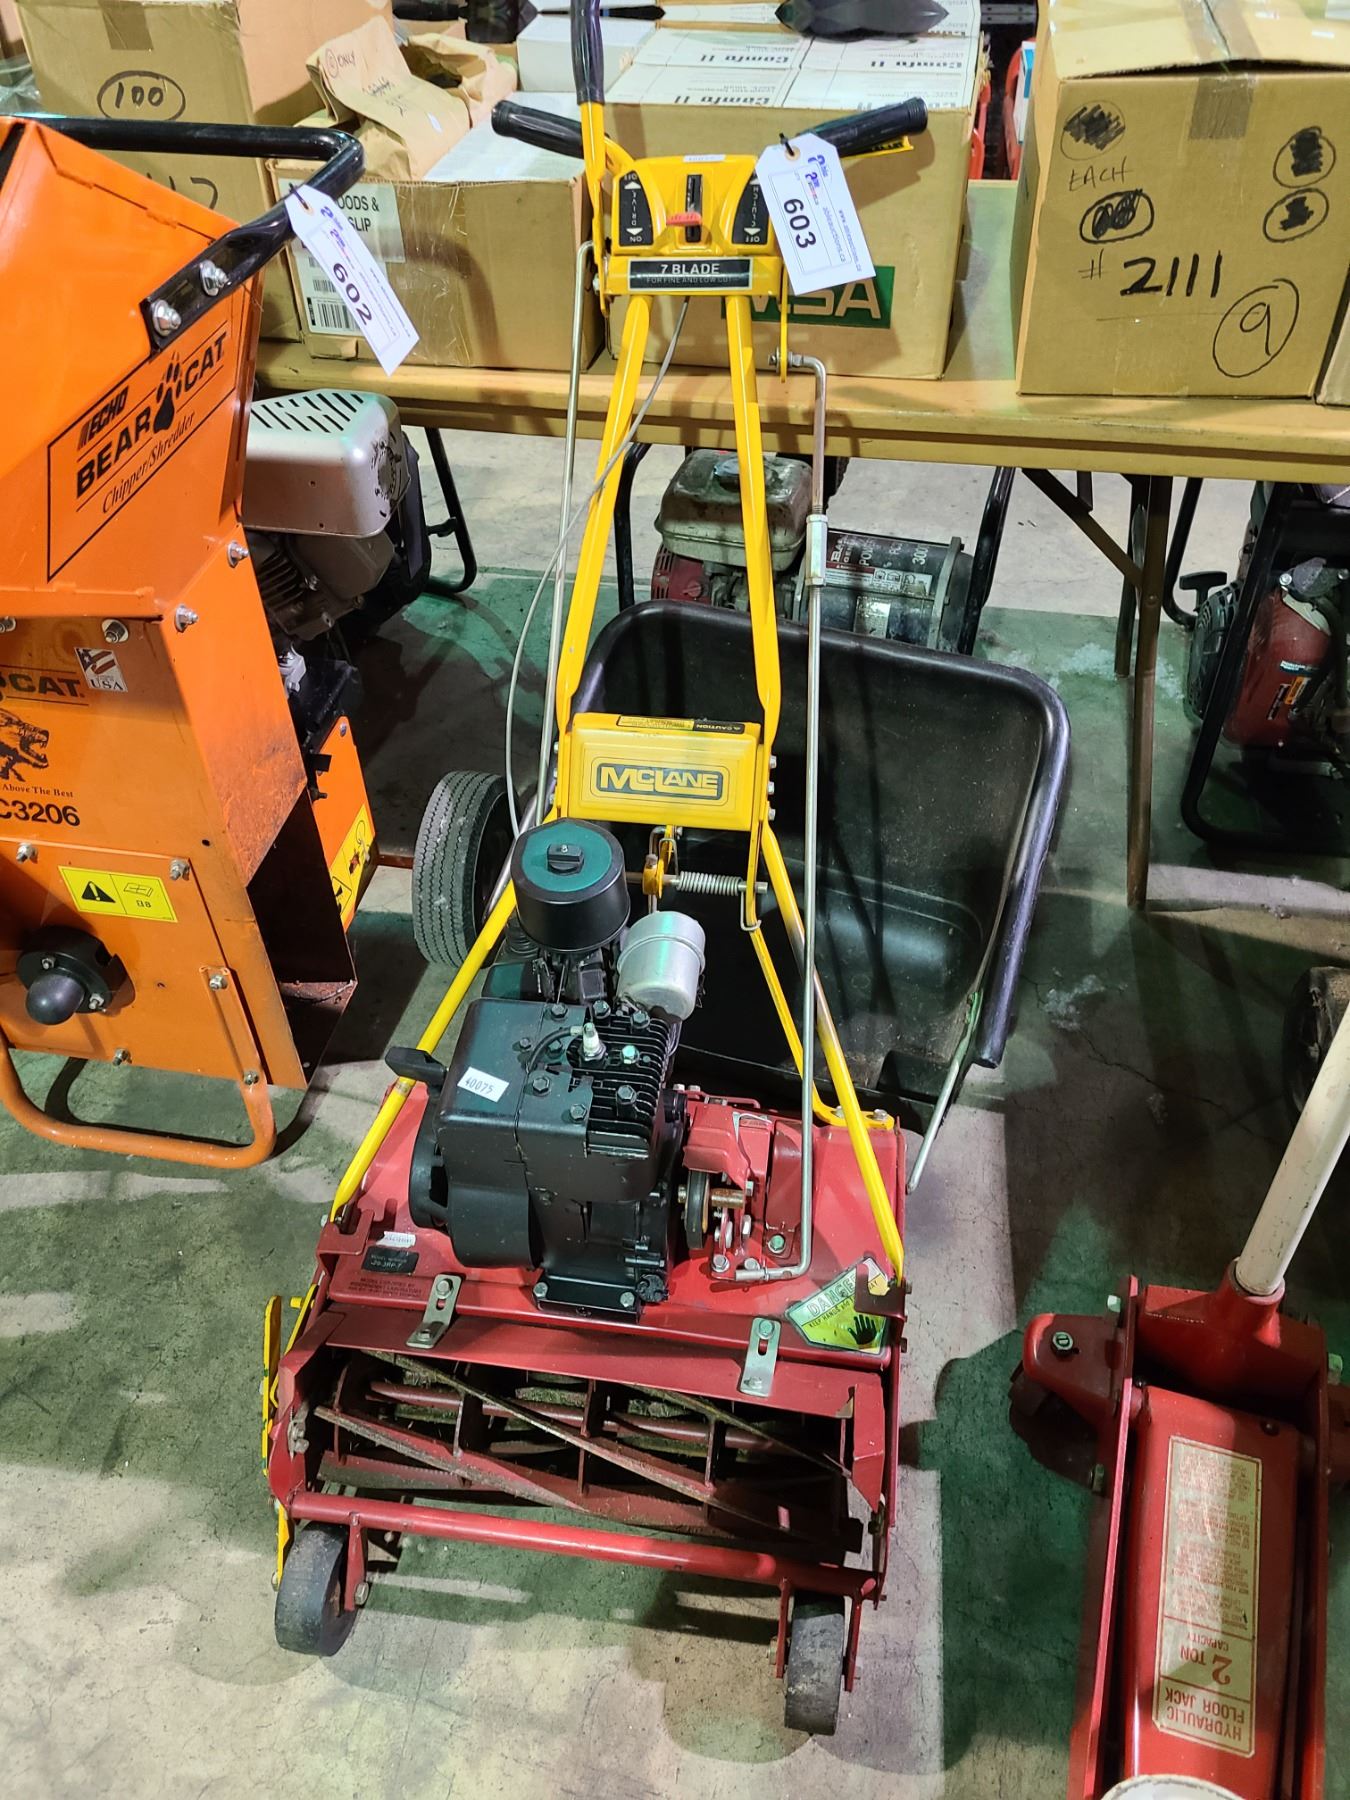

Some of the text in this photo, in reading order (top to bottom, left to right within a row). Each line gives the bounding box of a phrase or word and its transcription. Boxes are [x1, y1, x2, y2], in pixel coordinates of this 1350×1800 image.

[115, 79, 164, 109] 100
[1069, 156, 1133, 192] EACH
[337, 194, 381, 213] OODS &
[629, 235, 642, 243] ON
[745, 235, 761, 243] OFF
[783, 198, 817, 249] 603
[660, 263, 720, 275] 7 BLADE
[1120, 250, 1223, 298] 2111
[333, 263, 373, 326] 602
[76, 332, 227, 499] BEAR CAT
[84, 386, 129, 446] ECHO
[102, 410, 195, 514] Chipper/Shredder
[90, 679, 124, 691] USA
[3, 783, 74, 798] Above The Best
[464, 1076, 496, 1096] 40075
[807, 1274, 856, 1318] DANGE
[1187, 1632, 1230, 1652] CAPACITY
[1180, 1645, 1233, 1686] 2 TON
[1165, 1687, 1245, 1725] FLOOR JACK
[1166, 1705, 1243, 1742] HYDRAULIC
